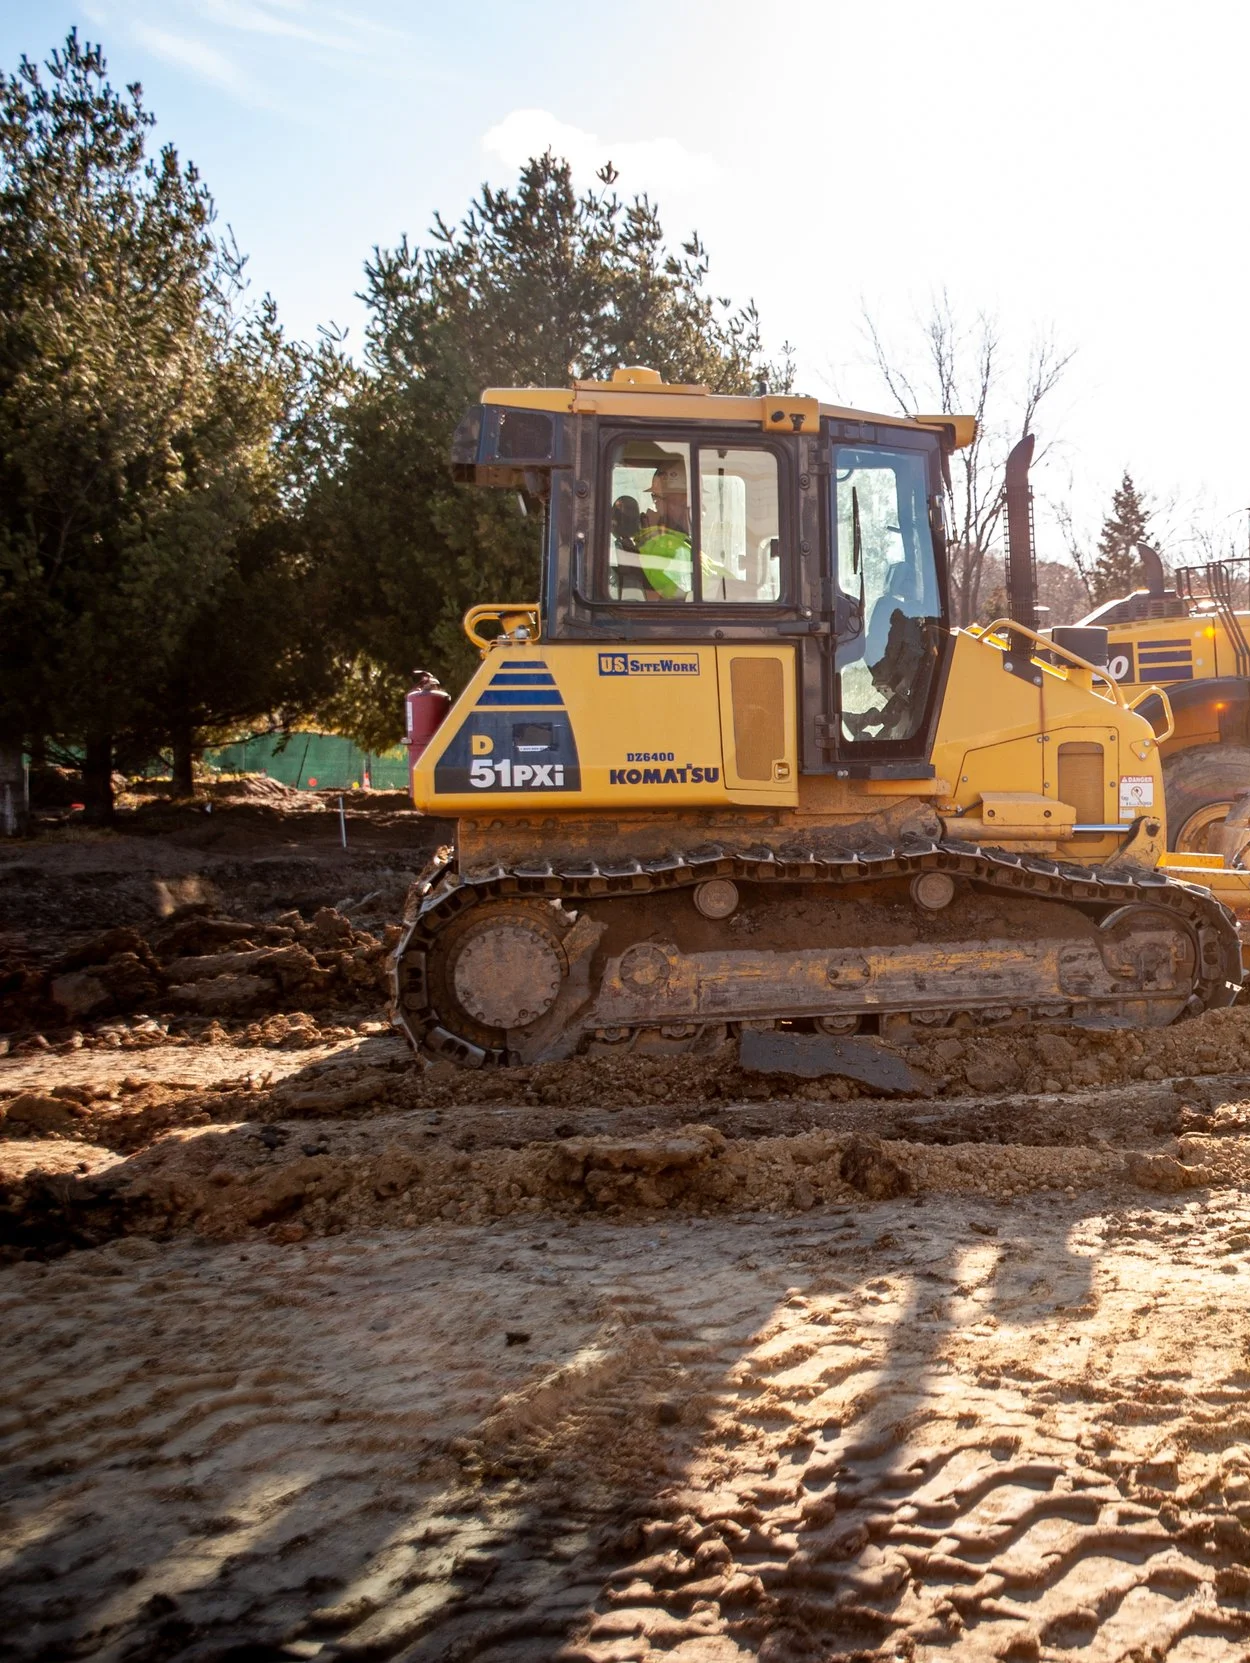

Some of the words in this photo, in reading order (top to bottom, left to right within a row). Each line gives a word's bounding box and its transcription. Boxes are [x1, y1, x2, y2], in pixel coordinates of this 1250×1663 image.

[600, 656, 628, 673] U.S.
[471, 734, 494, 756] D
[626, 752, 675, 762] DZ6400
[469, 758, 565, 788] 51PXi
[609, 763, 720, 785] KOMATSU
[1128, 775, 1153, 783] DANGER
